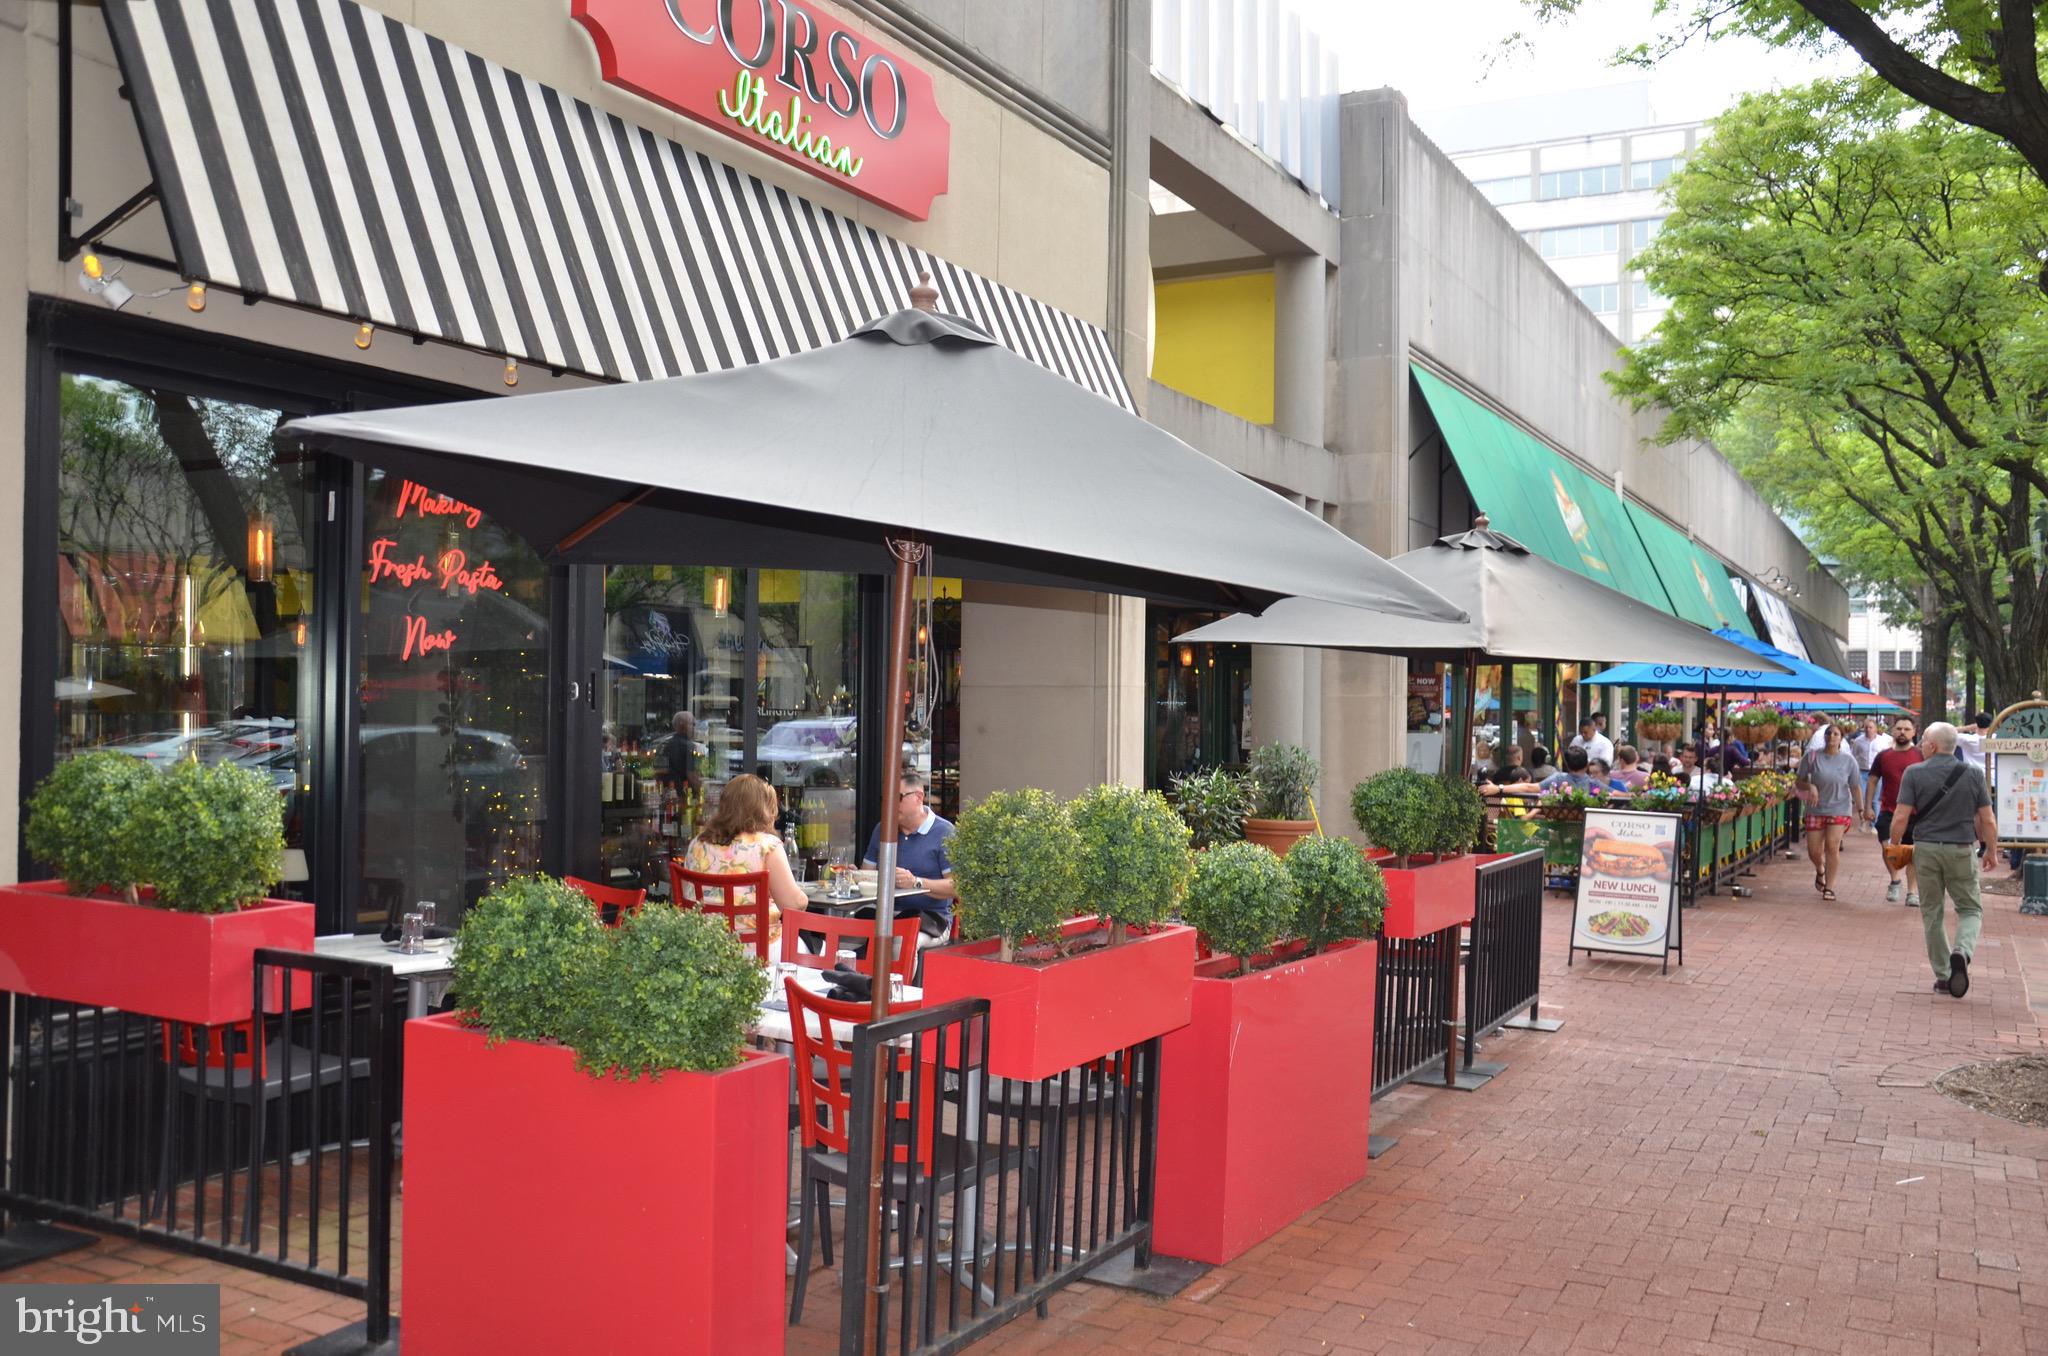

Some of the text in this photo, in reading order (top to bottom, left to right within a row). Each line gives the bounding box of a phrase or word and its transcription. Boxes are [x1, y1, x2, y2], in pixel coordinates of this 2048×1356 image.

[719, 68, 864, 178] Italian
[396, 479, 483, 529] Making
[369, 537, 503, 594] Fresh Pasta
[402, 615, 457, 661] Now
[1611, 821, 1650, 829] CORSO
[1593, 880, 1656, 893] NEW LUNCH
